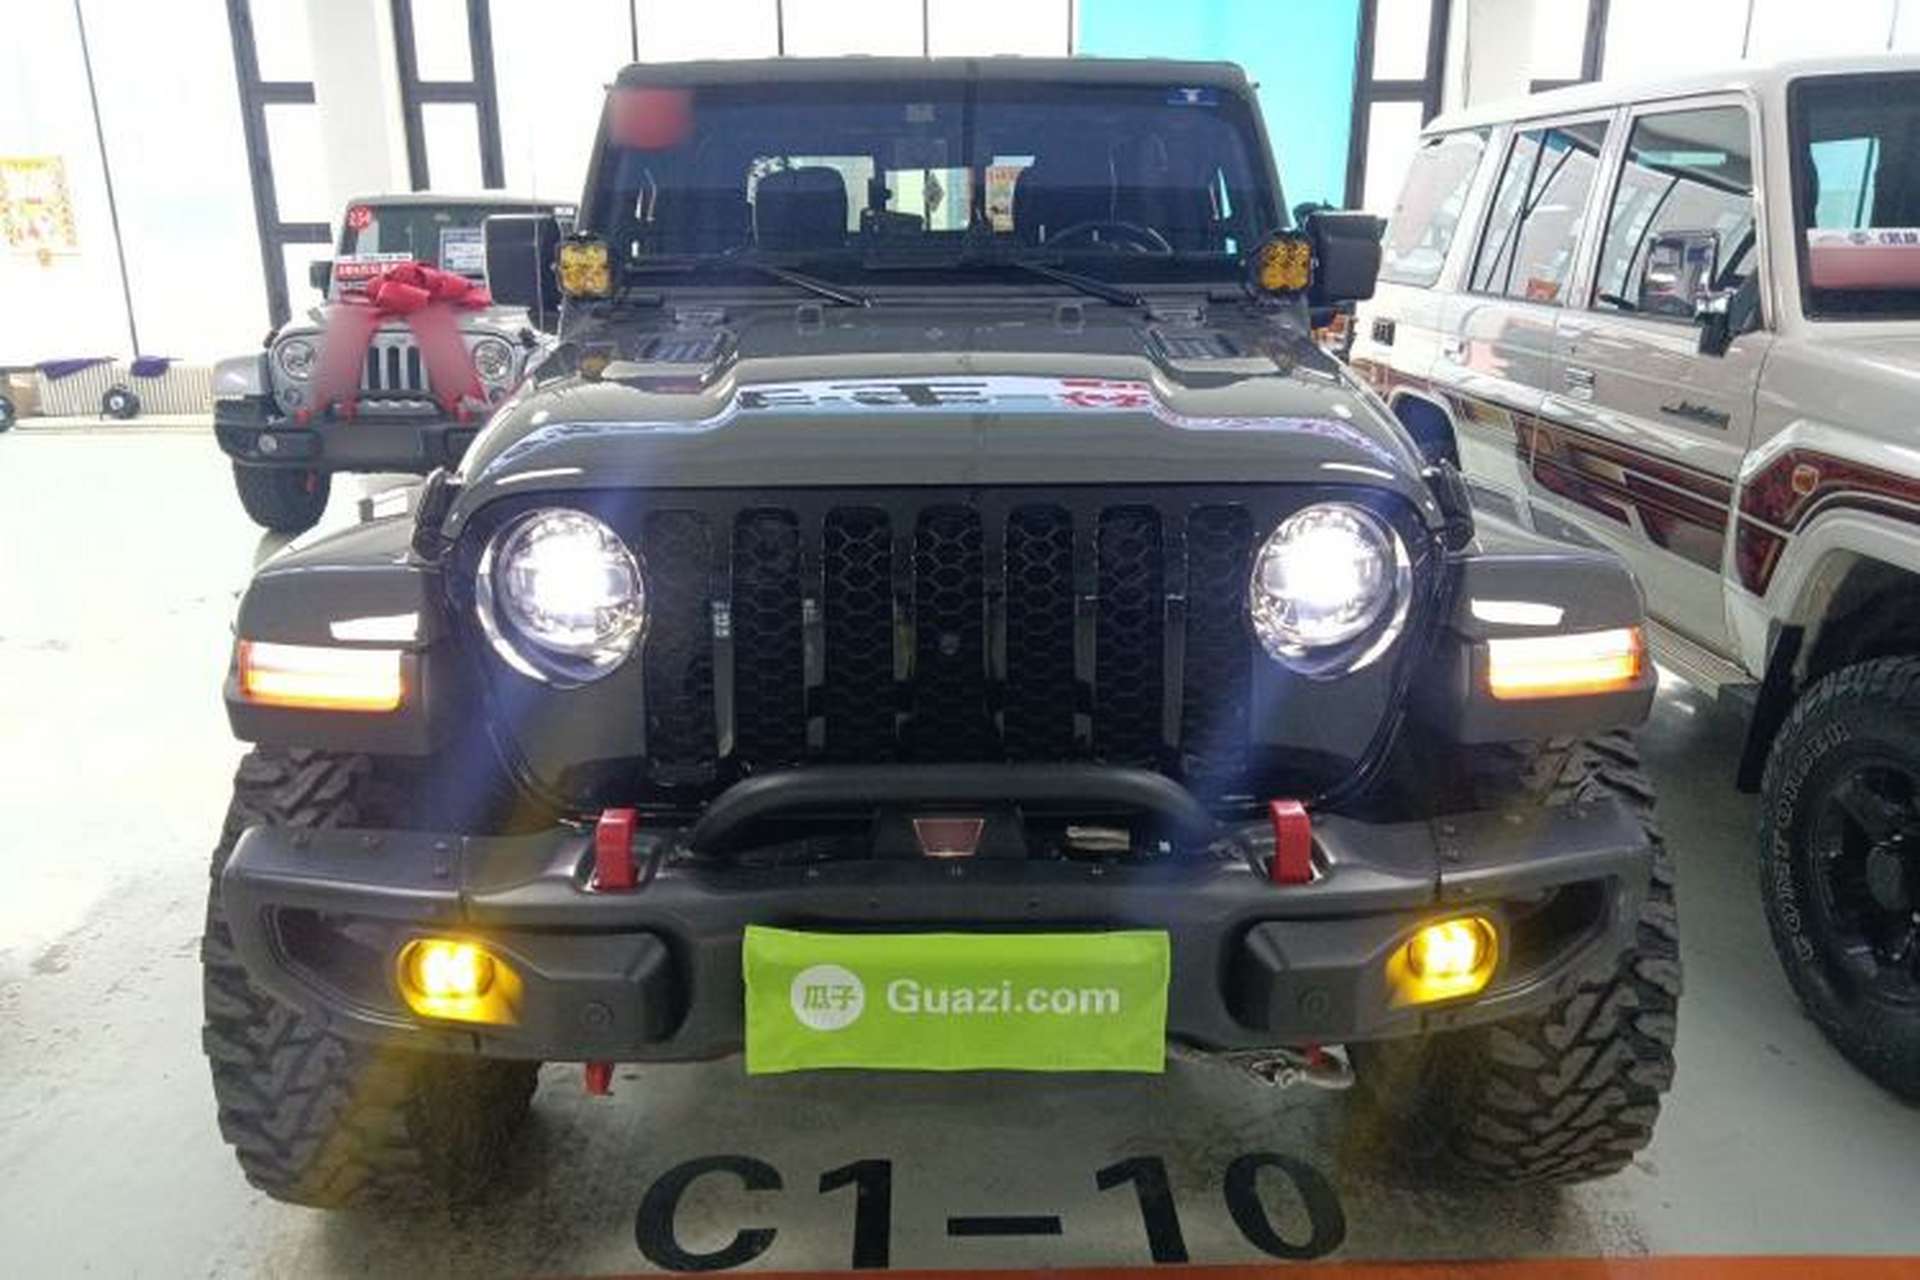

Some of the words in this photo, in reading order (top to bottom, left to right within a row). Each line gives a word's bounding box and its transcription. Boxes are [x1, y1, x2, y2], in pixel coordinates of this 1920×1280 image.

[802, 984, 859, 1011] 瓜子
[886, 978, 1120, 1015] Guazi.com
[633, 1151, 1347, 1271] C1-10
